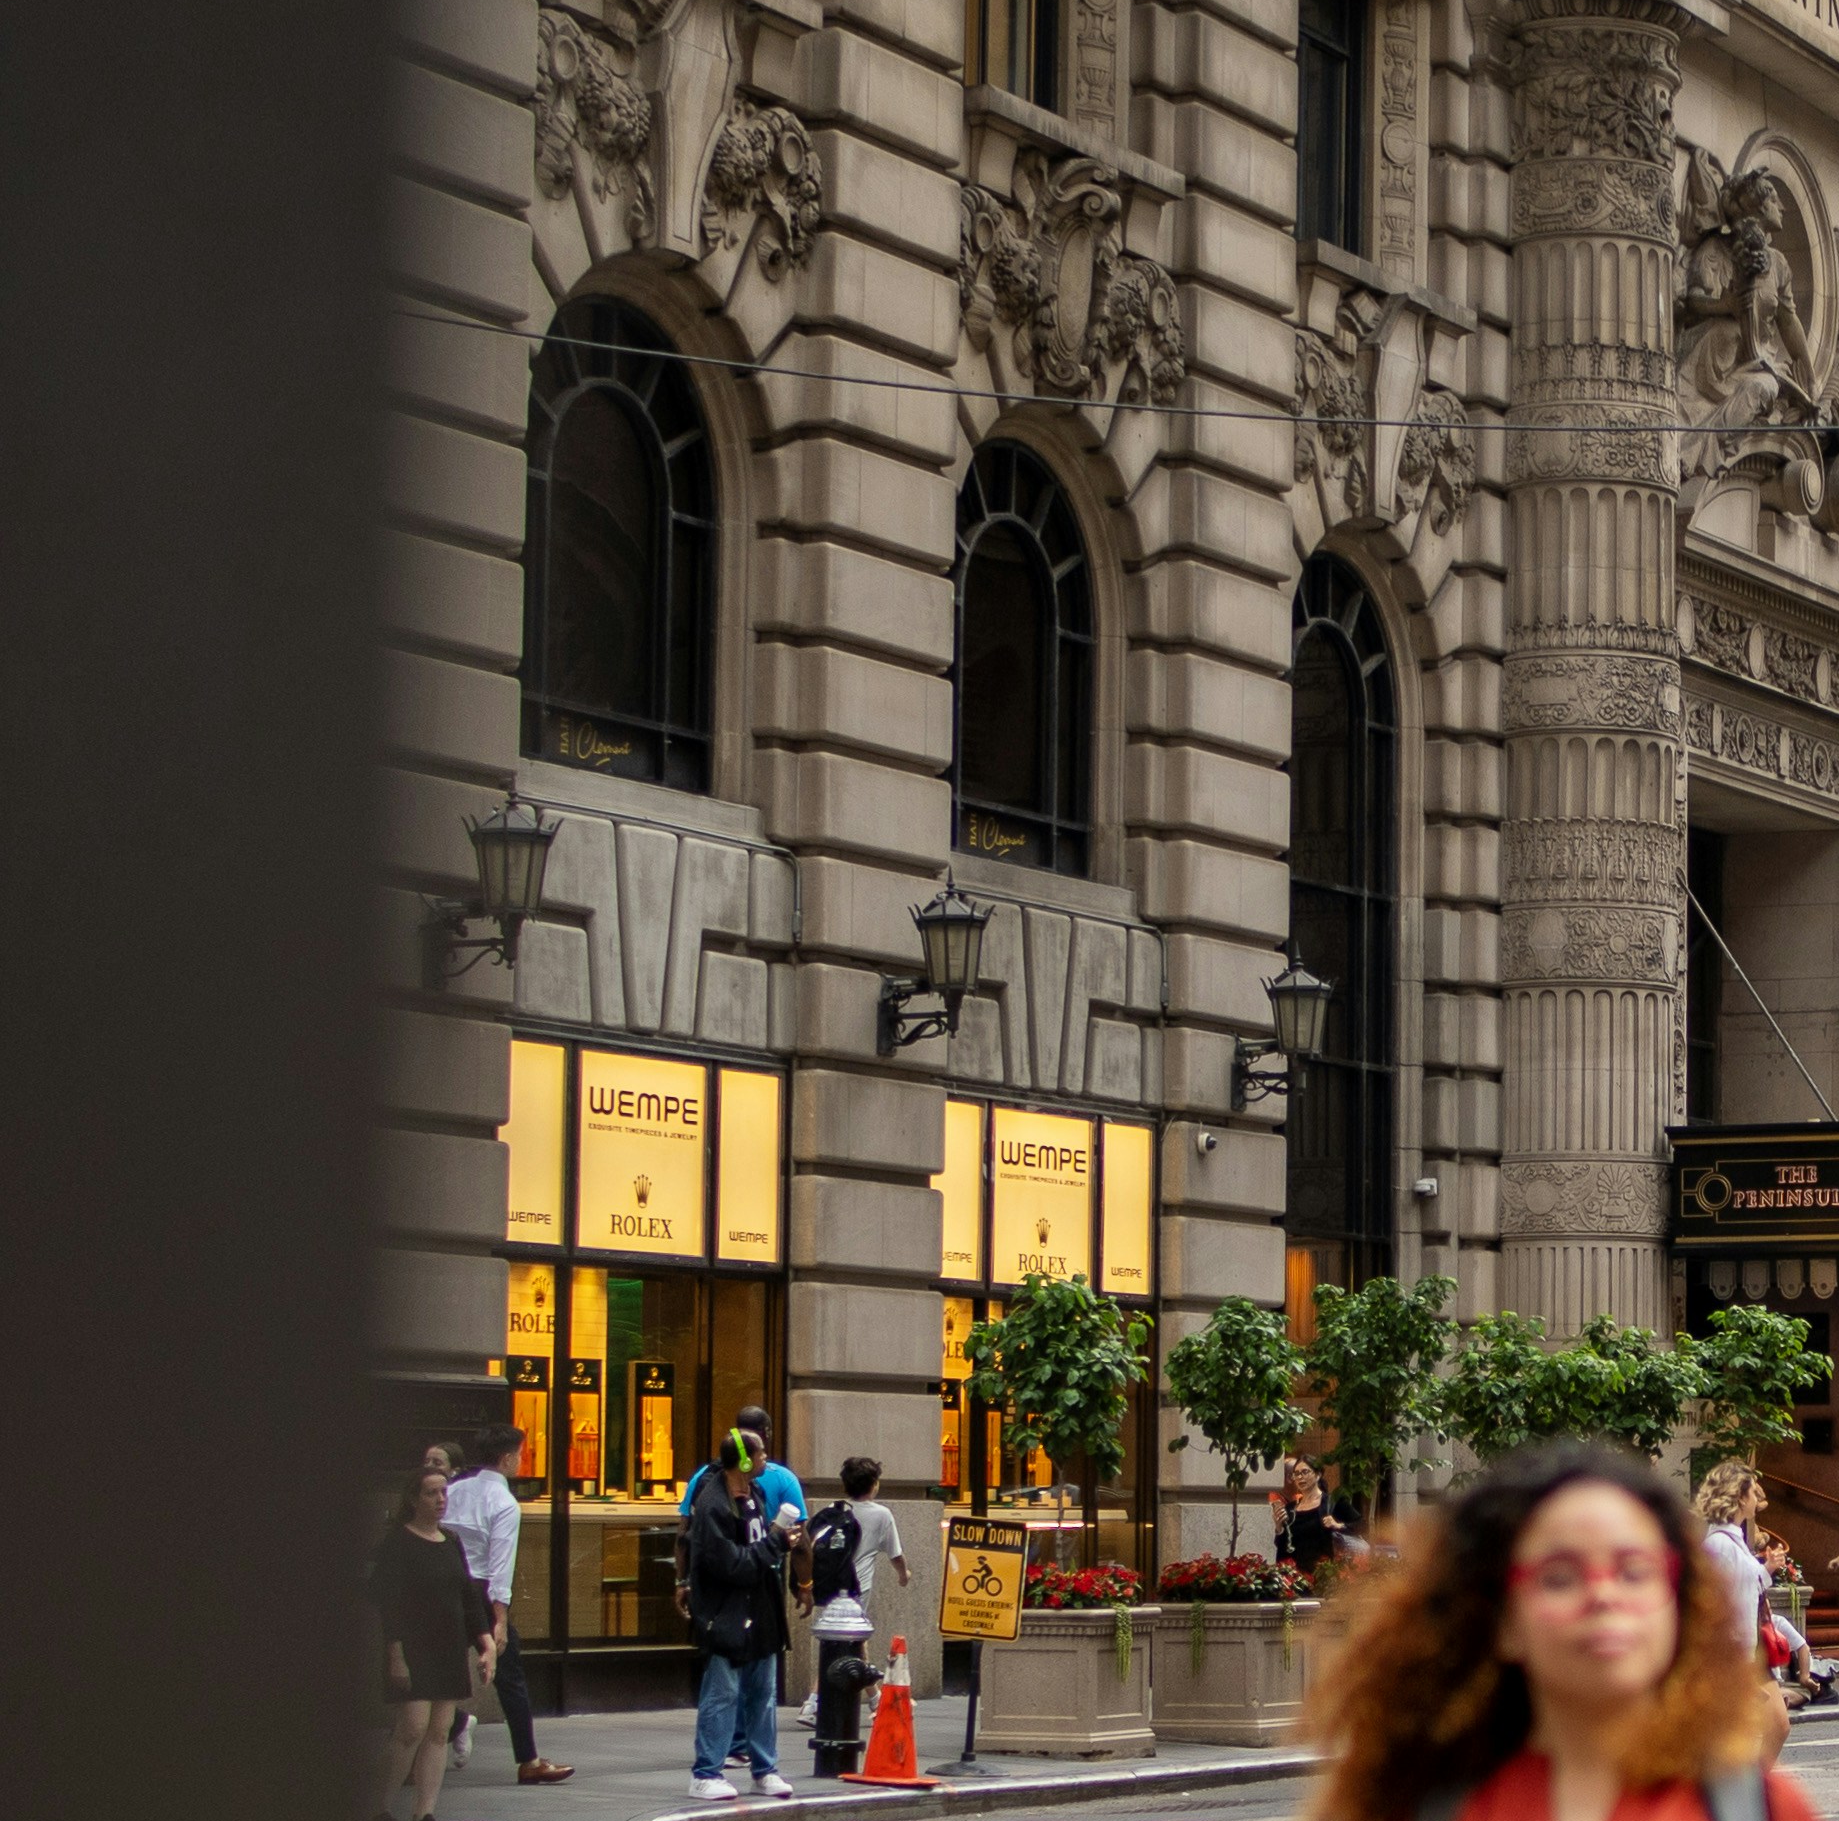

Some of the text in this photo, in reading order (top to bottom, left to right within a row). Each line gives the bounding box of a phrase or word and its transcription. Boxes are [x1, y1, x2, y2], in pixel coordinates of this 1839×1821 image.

[589, 1085, 698, 1126] WEMPE
[588, 1122, 622, 1133] EXQUISITE
[625, 1126, 662, 1138] TIMEPIECES
[1000, 1140, 1087, 1174] WEMPE
[1775, 1165, 1819, 1185] THE
[609, 1213, 674, 1240] ROLEX
[728, 1230, 769, 1245] WEMPE
[1017, 1252, 1068, 1276] ROLEX
[1110, 1266, 1143, 1279] WEMPE
[509, 1312, 556, 1334] ROLE
[953, 1524, 1023, 1547] SLOW DOWN
